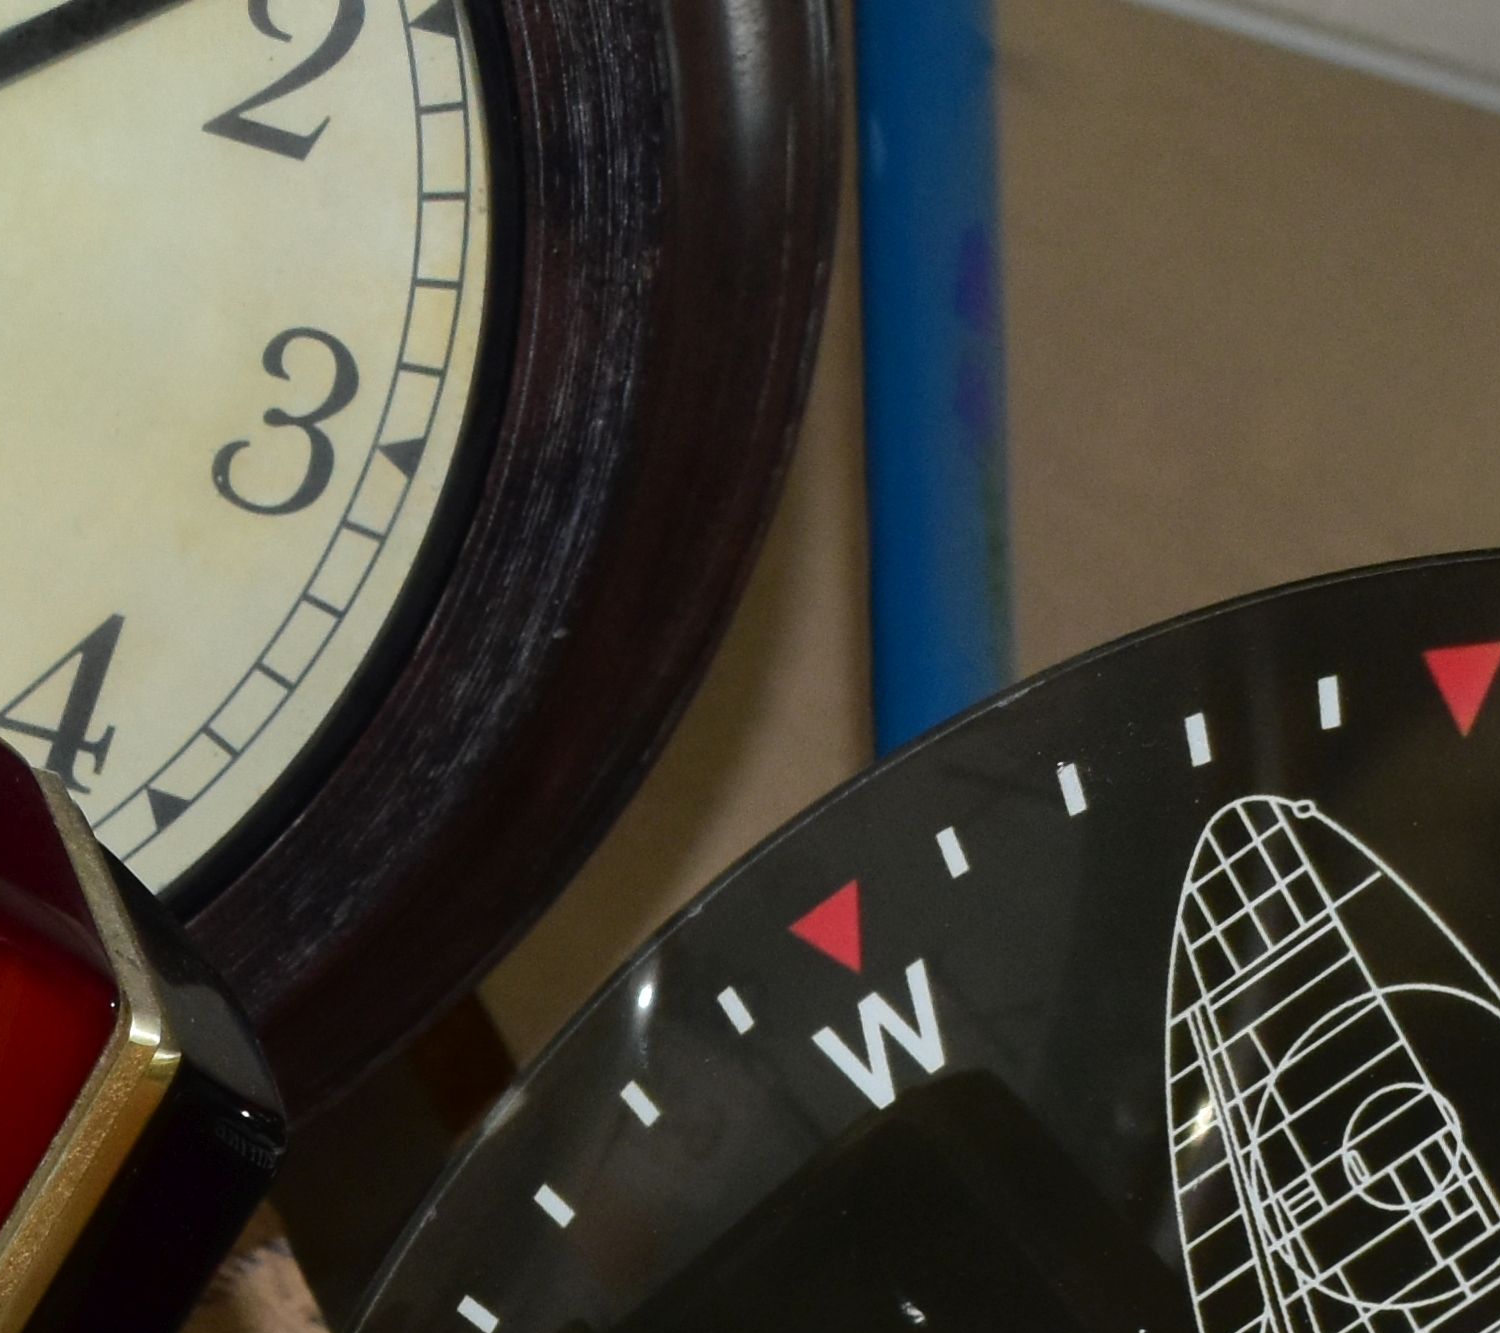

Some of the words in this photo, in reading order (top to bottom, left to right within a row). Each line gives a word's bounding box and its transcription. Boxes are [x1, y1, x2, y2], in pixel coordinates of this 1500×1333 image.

[203, 0, 365, 161] 2
[211, 328, 360, 517] 3
[811, 959, 945, 1111] W
